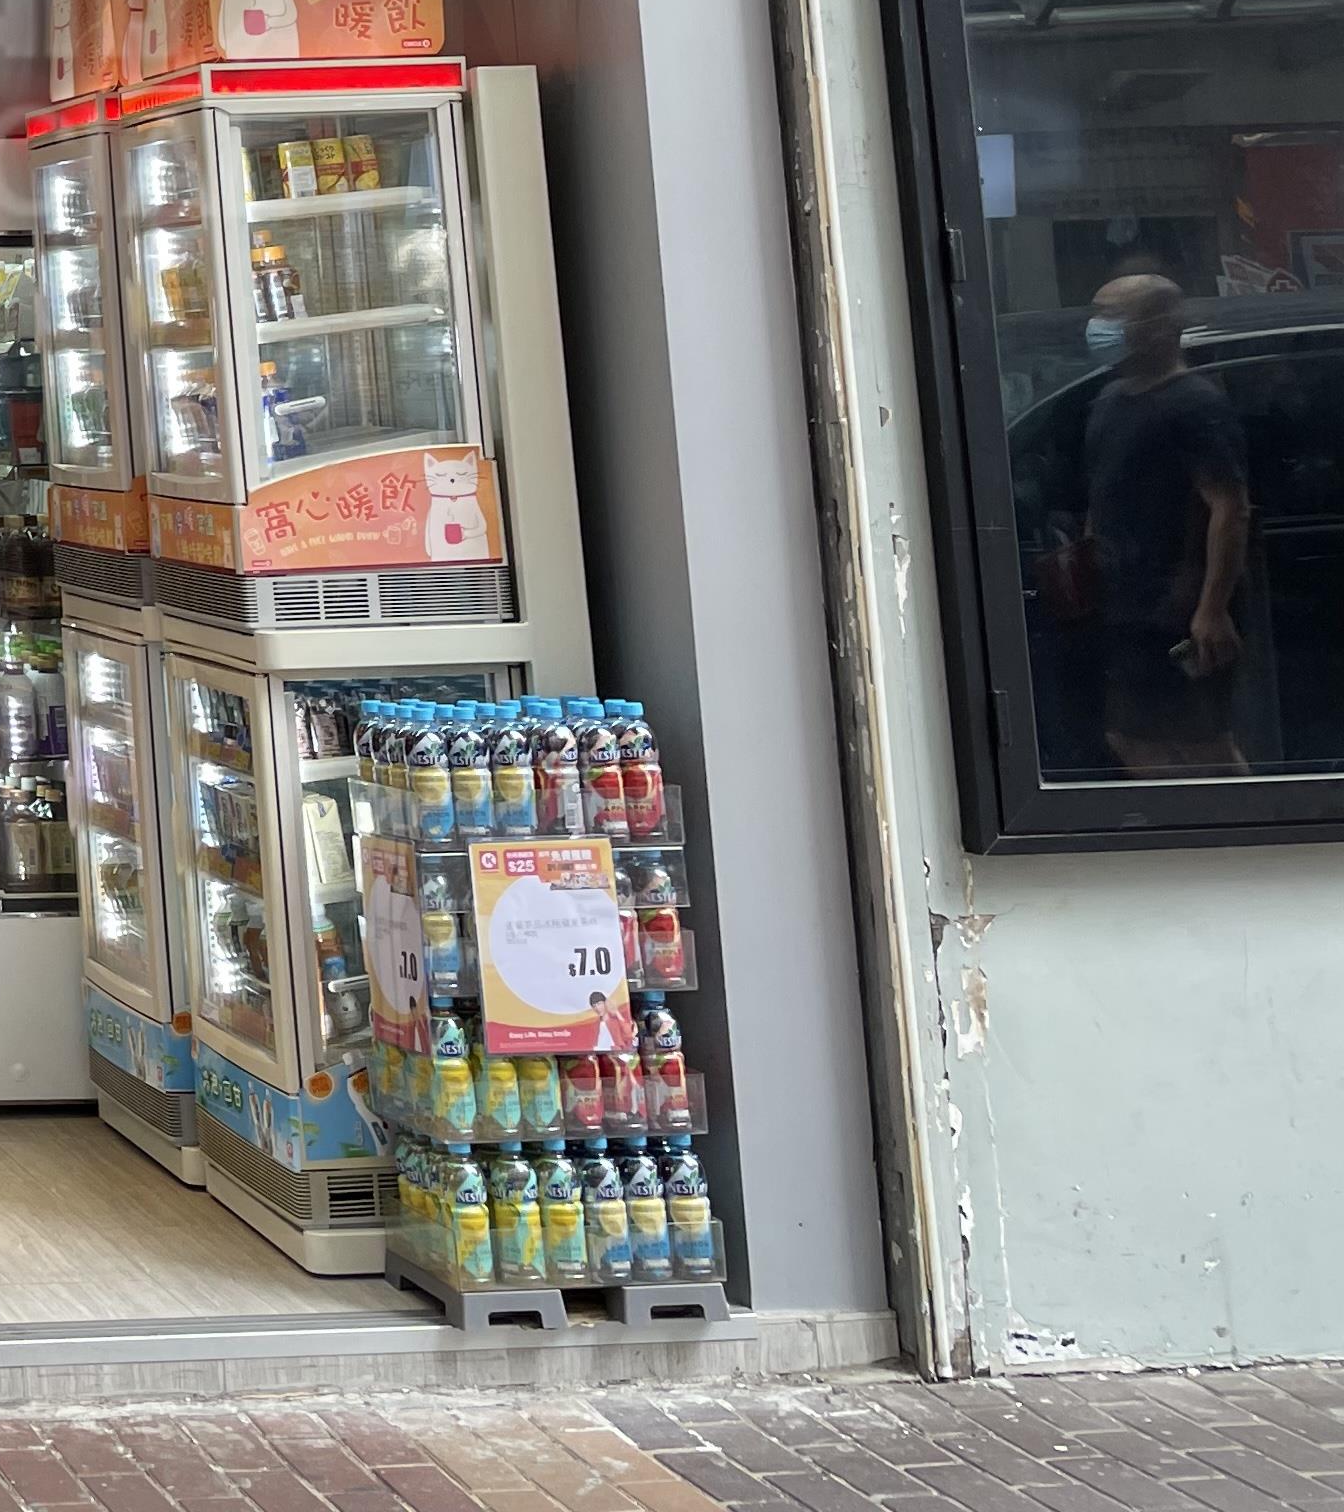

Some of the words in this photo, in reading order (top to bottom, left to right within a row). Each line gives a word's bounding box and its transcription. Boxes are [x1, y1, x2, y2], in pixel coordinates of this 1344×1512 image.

[255, 472, 417, 544] 窩心暖飲
[508, 859, 536, 873] $25
[568, 946, 612, 978] $7.0
